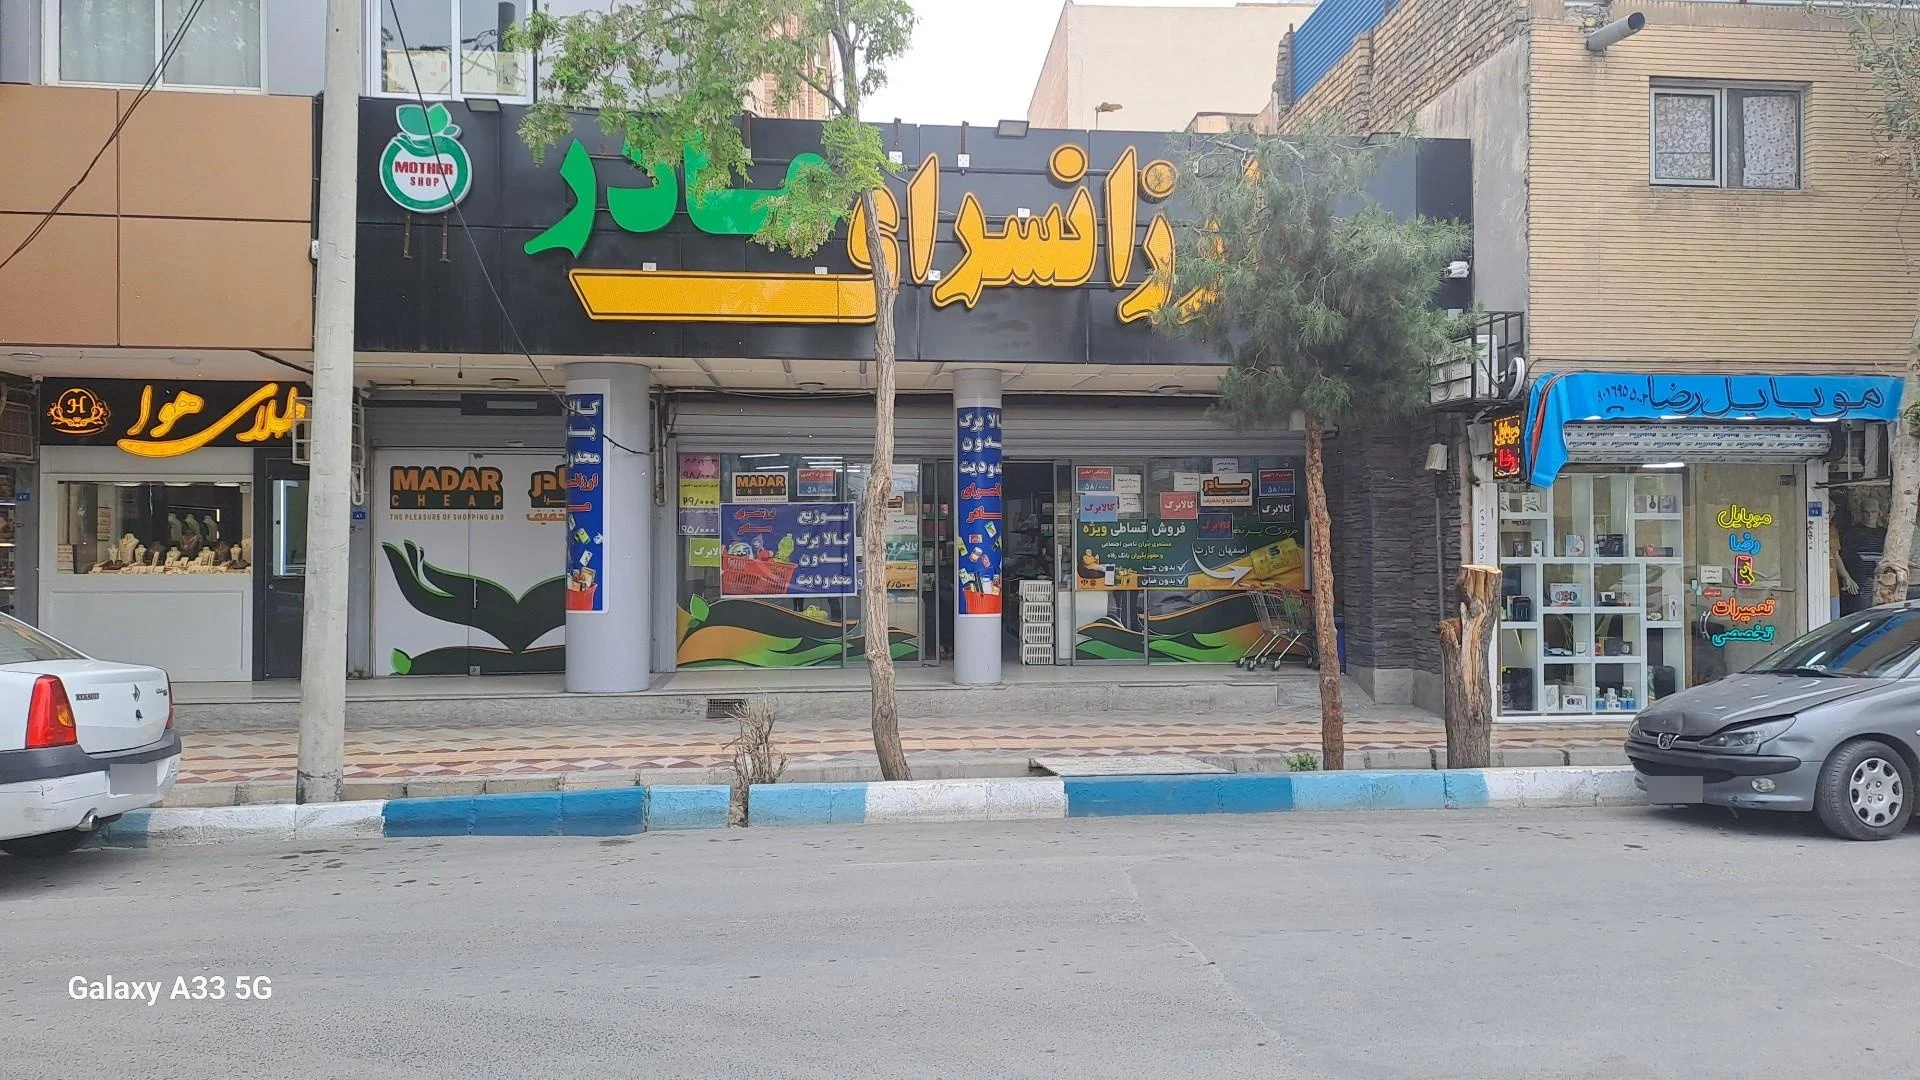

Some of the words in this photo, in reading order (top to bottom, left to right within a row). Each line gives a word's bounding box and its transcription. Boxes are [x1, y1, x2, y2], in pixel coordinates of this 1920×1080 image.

[395, 161, 454, 175] MOTHER
[410, 177, 440, 187] SHOP
[1647, 376, 1703, 415] رضا
[1701, 376, 1885, 417] موبایل
[393, 469, 500, 491] MADAR
[736, 475, 785, 487] MADAR
[391, 495, 502, 508] CHEAP
[798, 508, 850, 526] توزیع
[1717, 504, 1772, 529] موبایل
[1083, 520, 1108, 537] ویژه
[1152, 521, 1186, 537] فروش
[1195, 545, 1215, 557] کارت
[1218, 545, 1248, 557] اصفهان
[1729, 532, 1761, 554] رضا
[799, 553, 849, 568] بدون
[1712, 597, 1775, 622] تعمیرات
[1712, 625, 1775, 647] تخصصی
